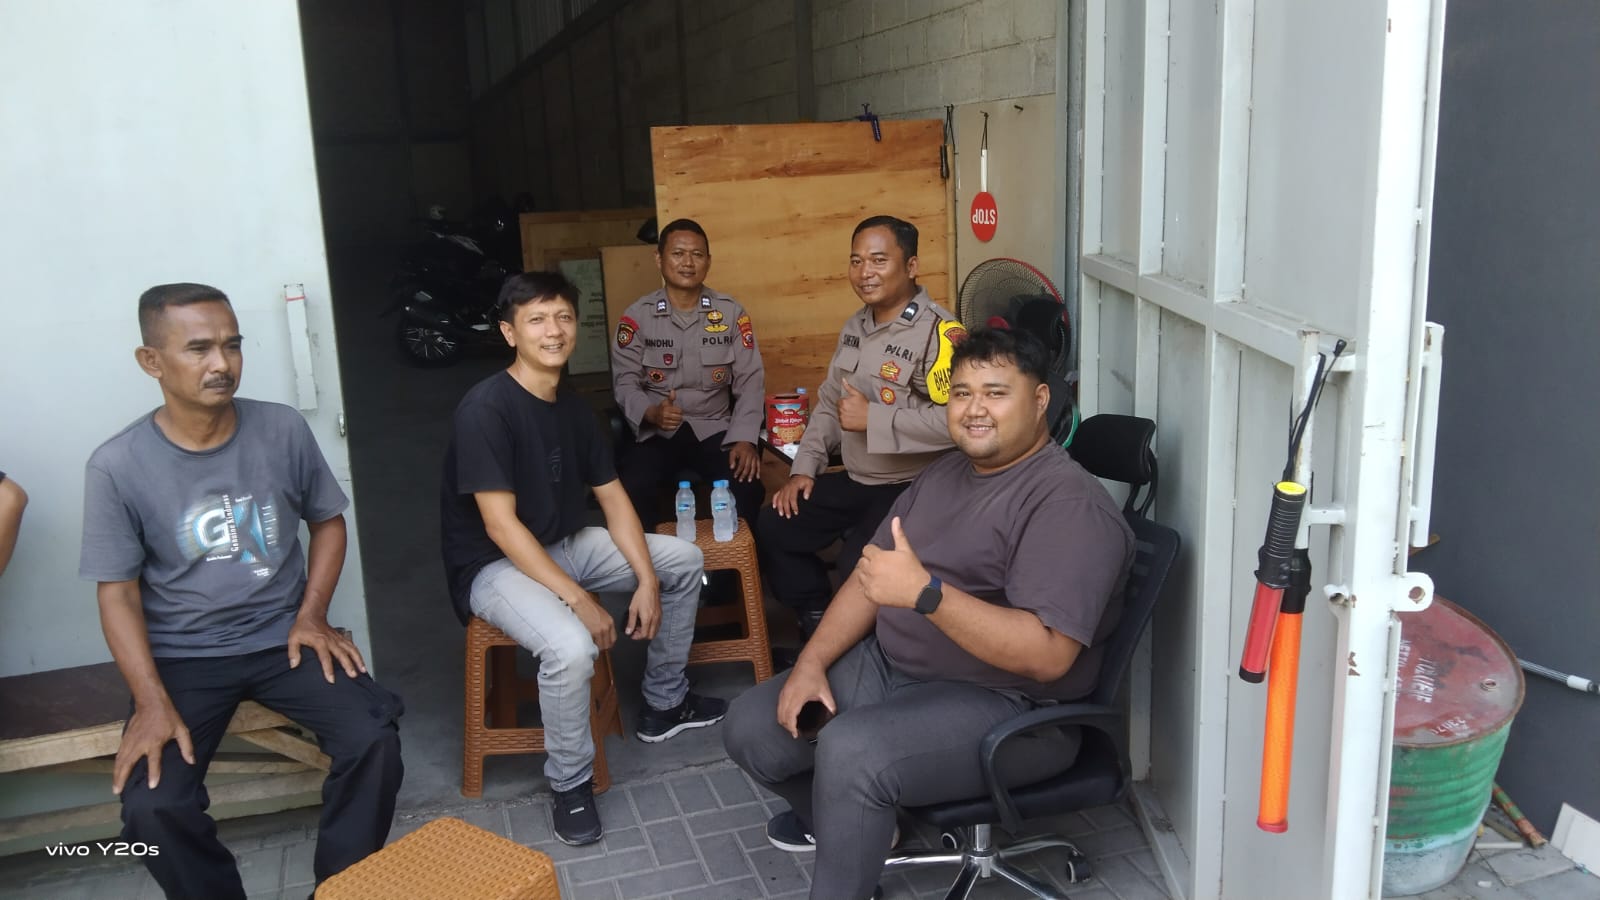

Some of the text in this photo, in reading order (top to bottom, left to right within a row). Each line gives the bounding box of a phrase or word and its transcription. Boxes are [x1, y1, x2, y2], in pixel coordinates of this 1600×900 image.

[972, 208, 996, 225] STOP
[703, 336, 733, 346] POLRI
[884, 344, 914, 361] POLRI
